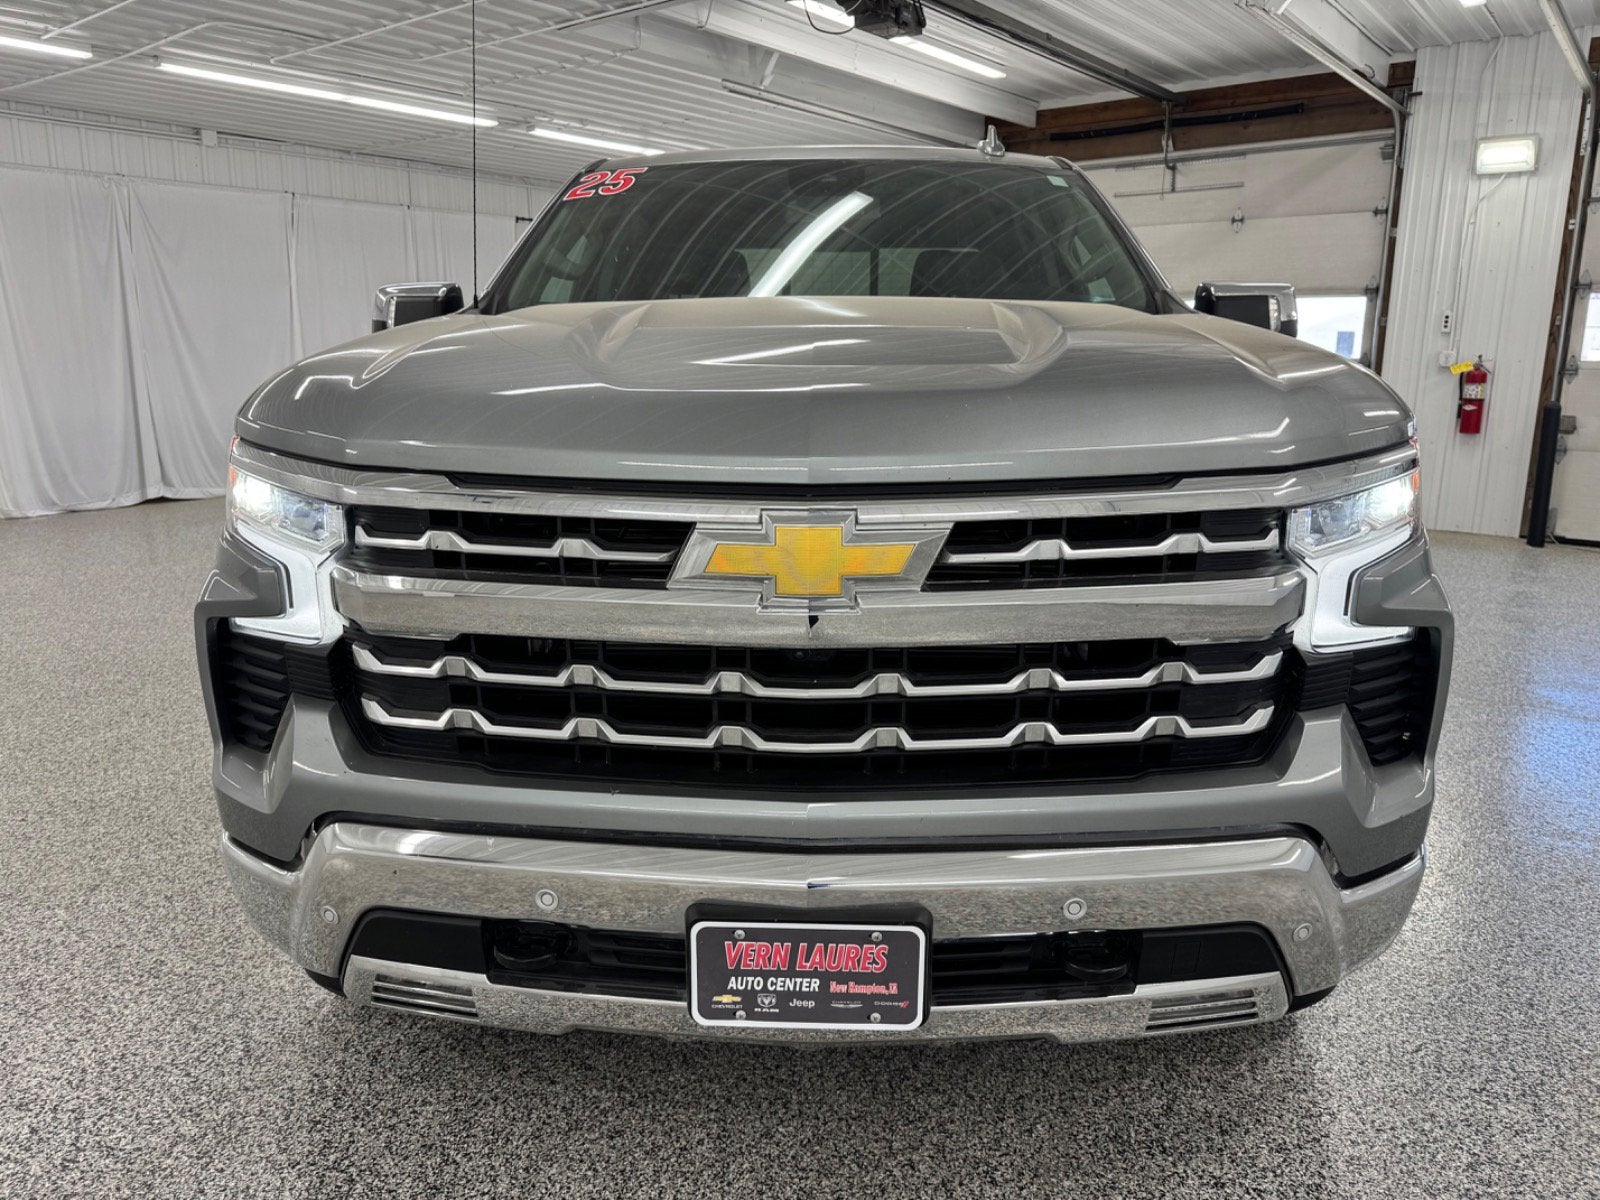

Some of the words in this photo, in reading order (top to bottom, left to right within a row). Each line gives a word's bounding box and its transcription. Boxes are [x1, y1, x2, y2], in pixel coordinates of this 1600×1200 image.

[563, 167, 648, 201] 25
[724, 941, 791, 971] VERN
[796, 942, 889, 973] LAURES
[727, 976, 764, 991] AUTO
[767, 977, 820, 993] CENTER
[829, 980, 848, 994] New
[789, 998, 816, 1009] Jeep
